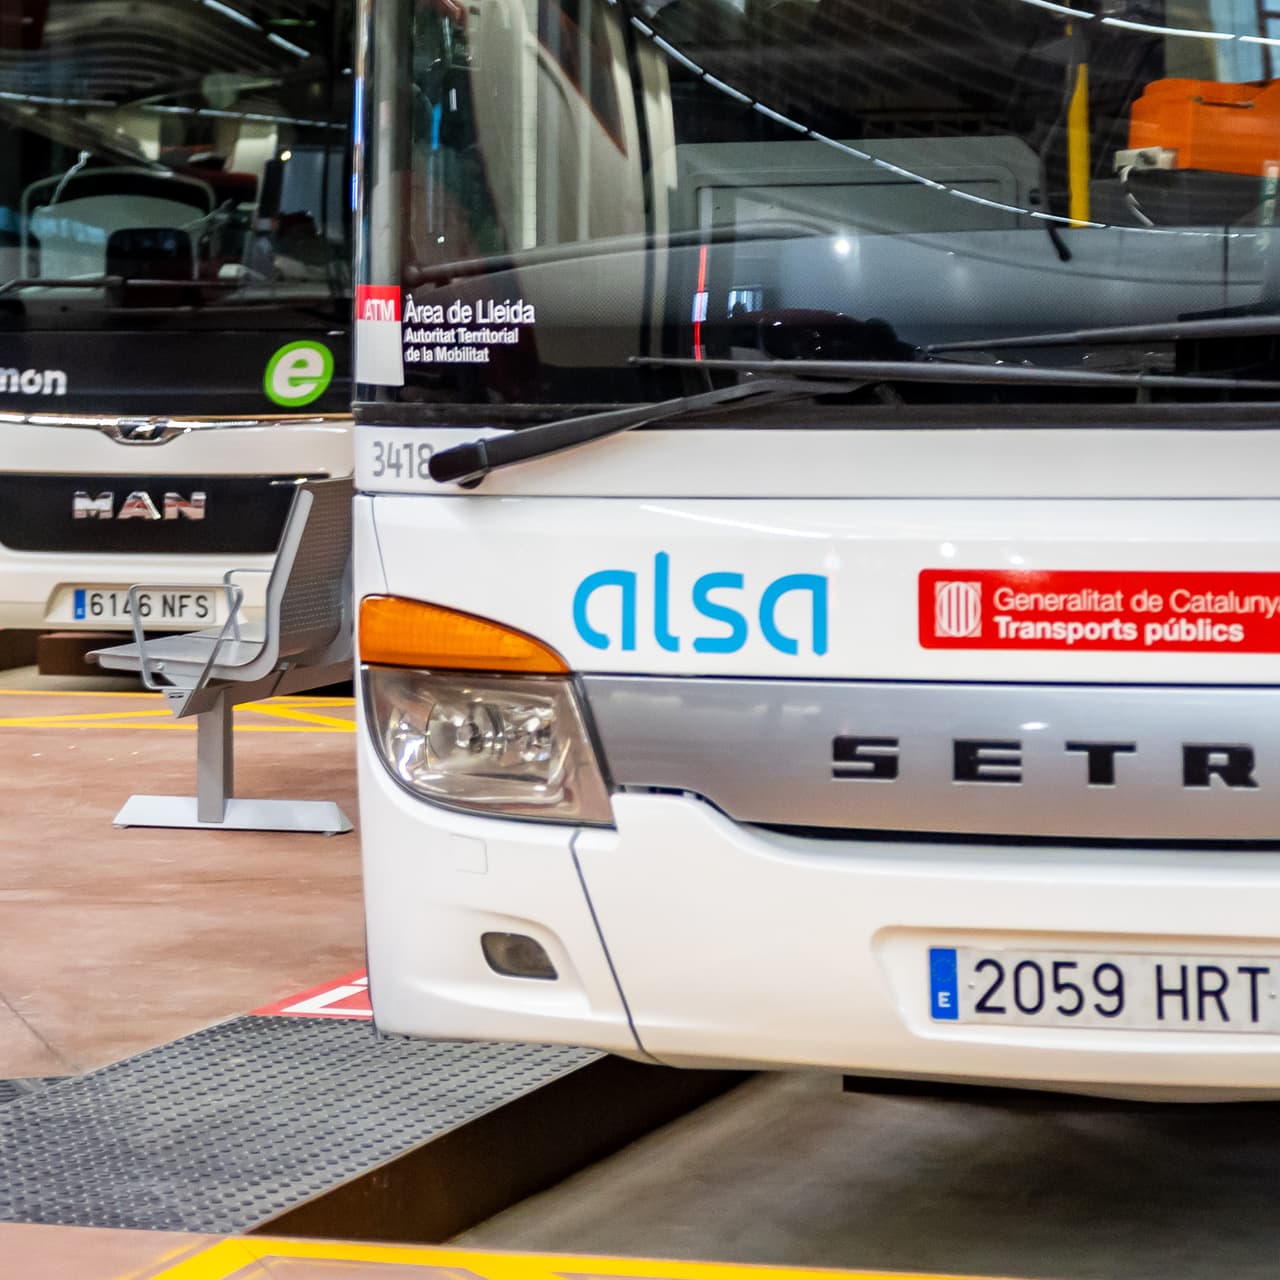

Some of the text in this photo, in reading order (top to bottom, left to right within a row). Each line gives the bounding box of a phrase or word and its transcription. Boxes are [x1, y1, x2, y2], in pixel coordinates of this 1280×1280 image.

[364, 293, 536, 323] ATM Àrea de Lleida
[404, 327, 519, 344] Autoritat Territorial
[405, 346, 490, 363] de la Mobilitat
[373, 441, 434, 480] 3418
[73, 491, 207, 520] MAN
[162, 594, 209, 618] NFS
[573, 550, 828, 656] alsa
[993, 587, 1125, 613] Generalitat
[1130, 587, 1163, 613] de
[993, 615, 1245, 645] Transports públics
[937, 958, 1271, 1023] E 2059 HRT
